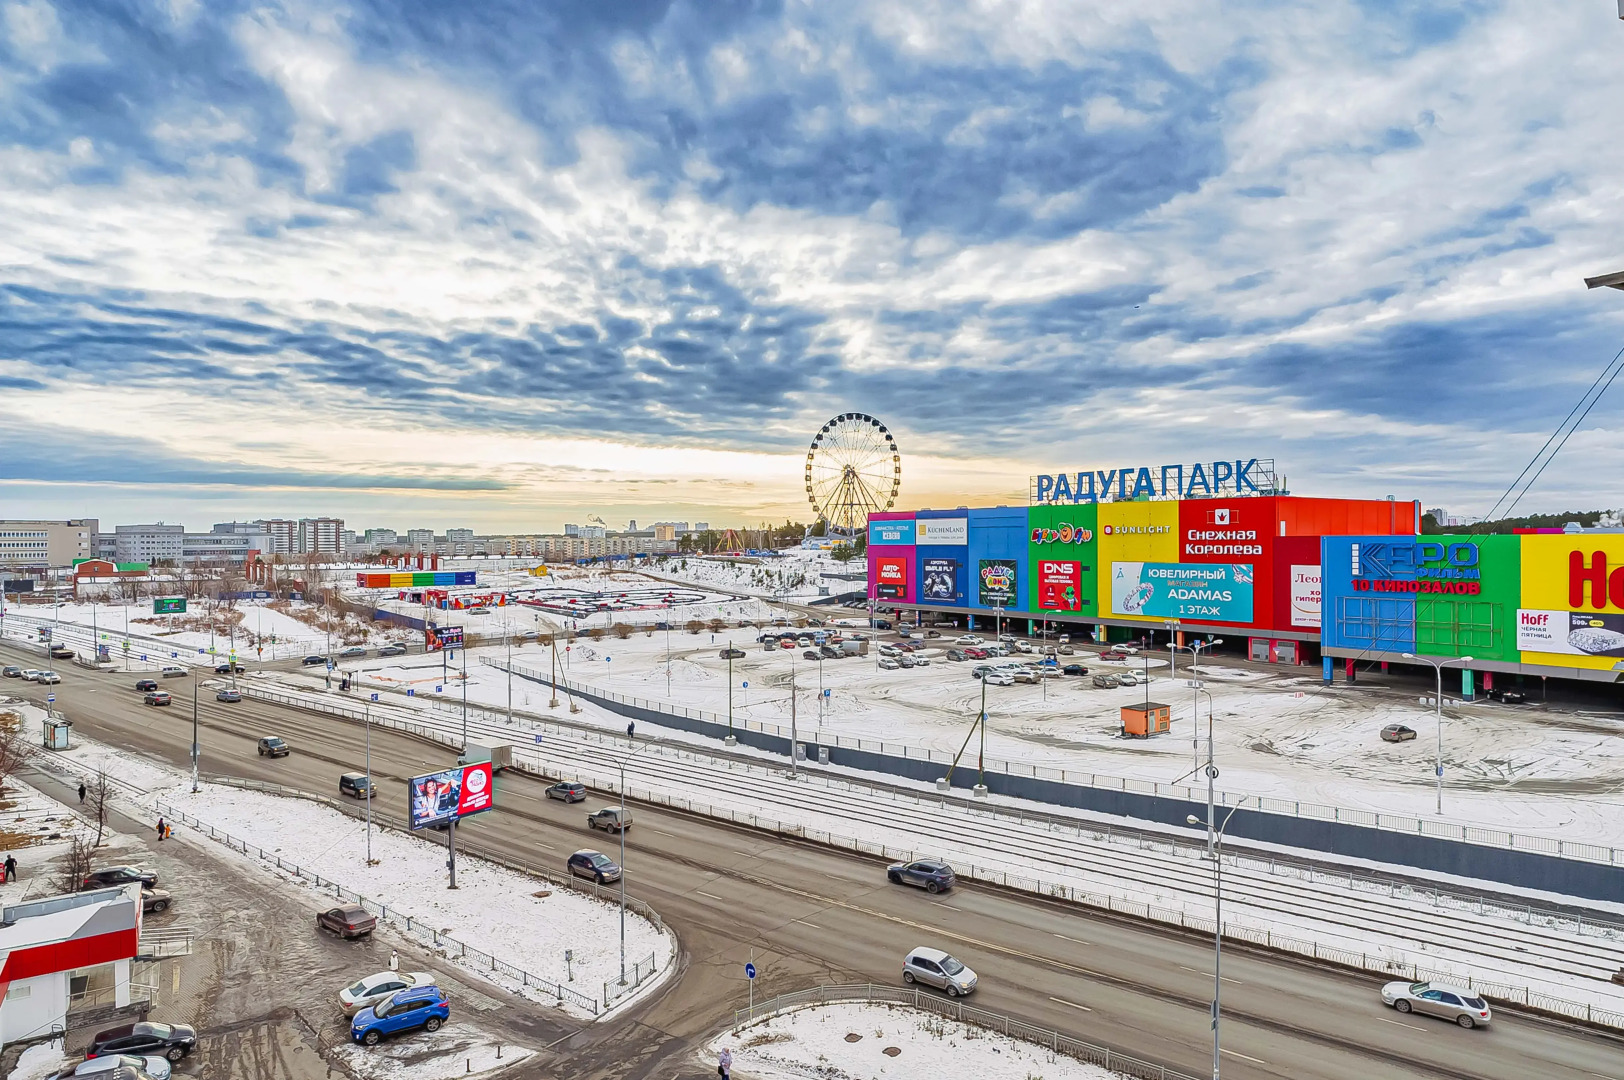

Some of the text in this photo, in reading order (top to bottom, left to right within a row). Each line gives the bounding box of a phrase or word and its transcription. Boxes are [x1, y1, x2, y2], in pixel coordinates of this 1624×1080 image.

[1115, 525, 1171, 535] SUNLIGHT
[1187, 529, 1257, 541] Снежная
[1185, 543, 1263, 556] Королева
[1044, 563, 1074, 574] DNS
[1148, 568, 1226, 580] ЮВЕЛИРНЫЙ
[1167, 580, 1208, 588] МАГАЗИН
[1351, 579, 1481, 595] 10 КИНОЗАЛОВ
[1167, 588, 1232, 602] ADAMAS
[1179, 605, 1221, 616] 1 ЭТАЖ
